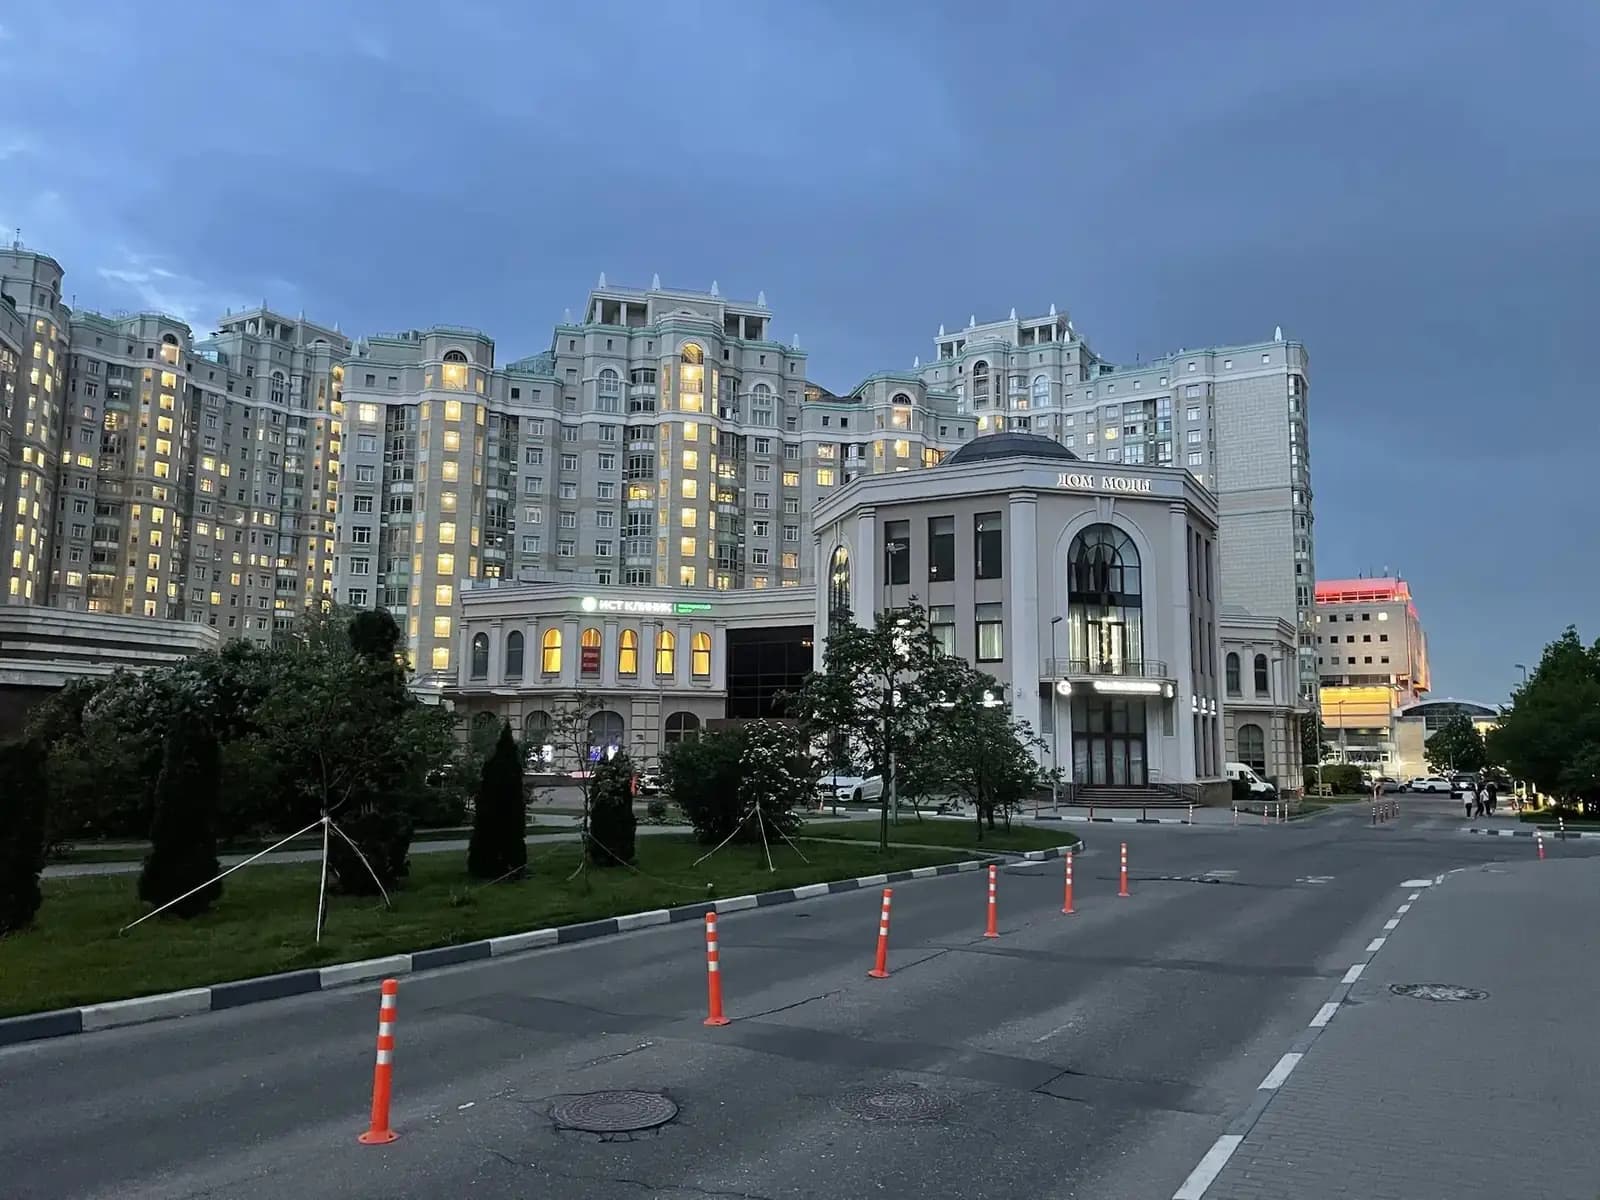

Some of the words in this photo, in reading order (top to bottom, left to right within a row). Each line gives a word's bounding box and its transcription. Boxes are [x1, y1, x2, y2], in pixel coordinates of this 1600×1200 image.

[1057, 472, 1095, 489] ДОМ
[1102, 476, 1152, 493] МОДЫ
[599, 599, 624, 610] ИСТ
